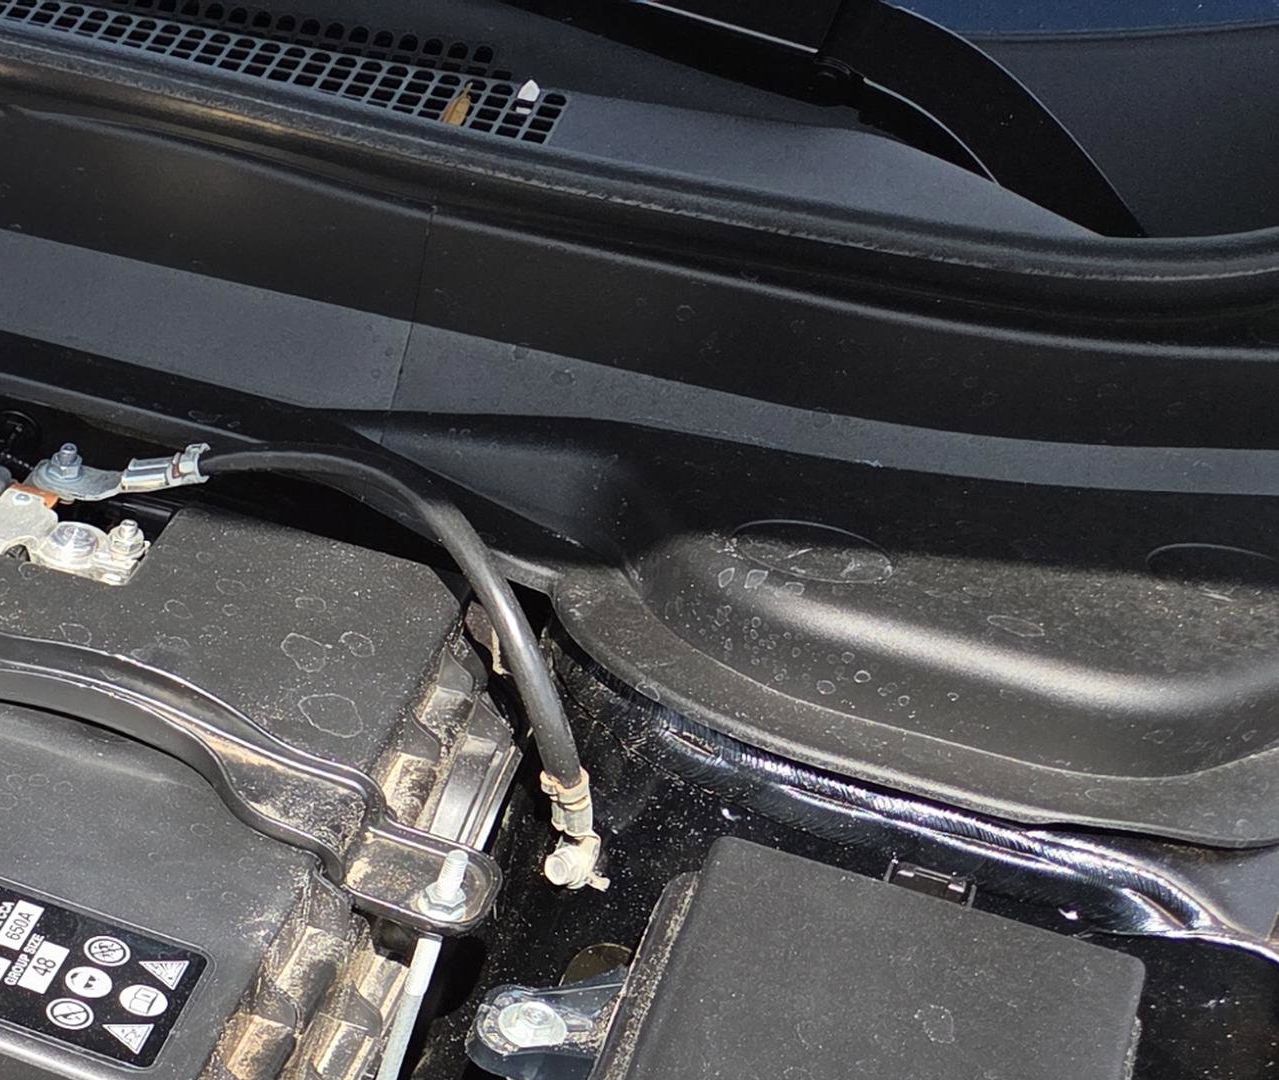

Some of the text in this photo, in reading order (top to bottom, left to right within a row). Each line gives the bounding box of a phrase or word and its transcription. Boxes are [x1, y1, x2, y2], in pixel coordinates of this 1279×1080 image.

[6, 910, 34, 940] 650A
[4, 932, 45, 986] GROUP SIZE
[31, 955, 56, 977] 48
